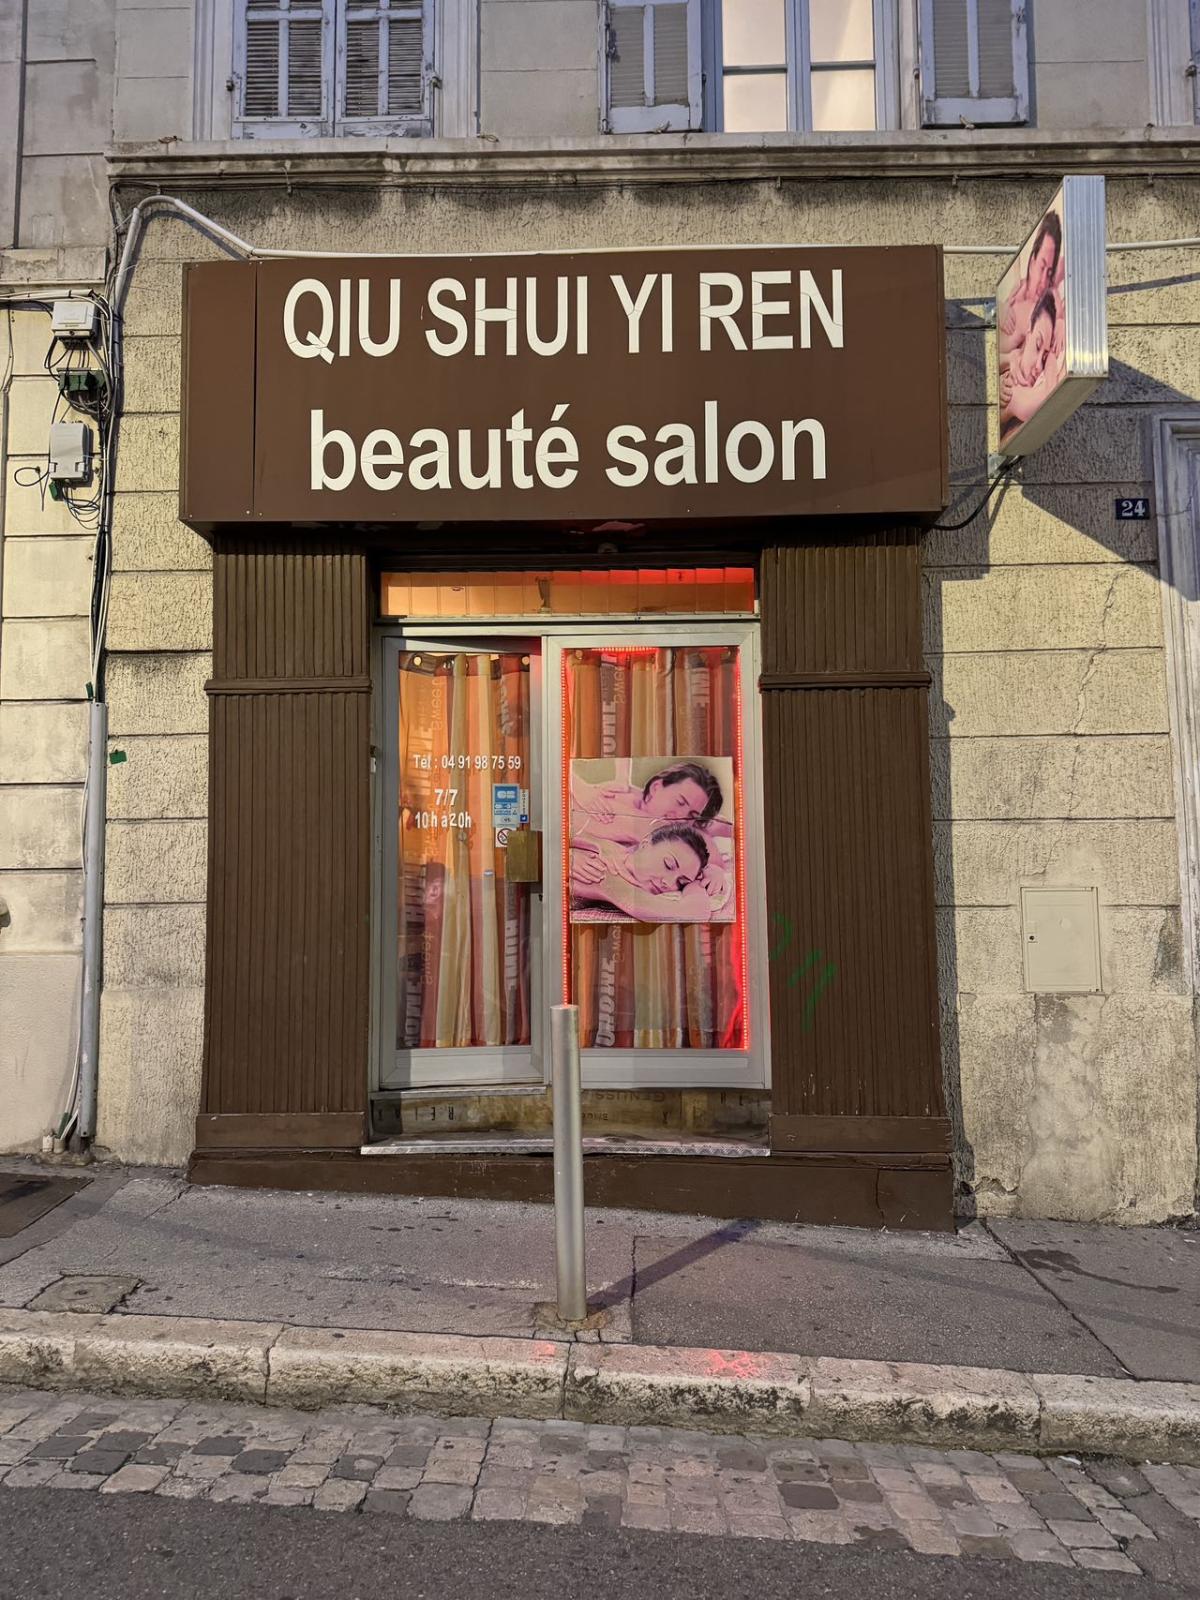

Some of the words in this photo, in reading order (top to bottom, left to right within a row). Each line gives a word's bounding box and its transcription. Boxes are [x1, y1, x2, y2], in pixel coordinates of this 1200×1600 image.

[283, 278, 402, 365] QIU
[425, 275, 589, 358] SHUI
[609, 273, 674, 355] YI
[699, 268, 845, 351] REN
[309, 403, 579, 492] beauté
[605, 399, 827, 487] salon
[1121, 501, 1146, 516] 24
[441, 755, 456, 769] 04
[458, 755, 471, 769] 91
[474, 755, 488, 769] 98
[492, 755, 505, 769] 75
[508, 755, 521, 769] 59
[434, 788, 458, 806] 7/7
